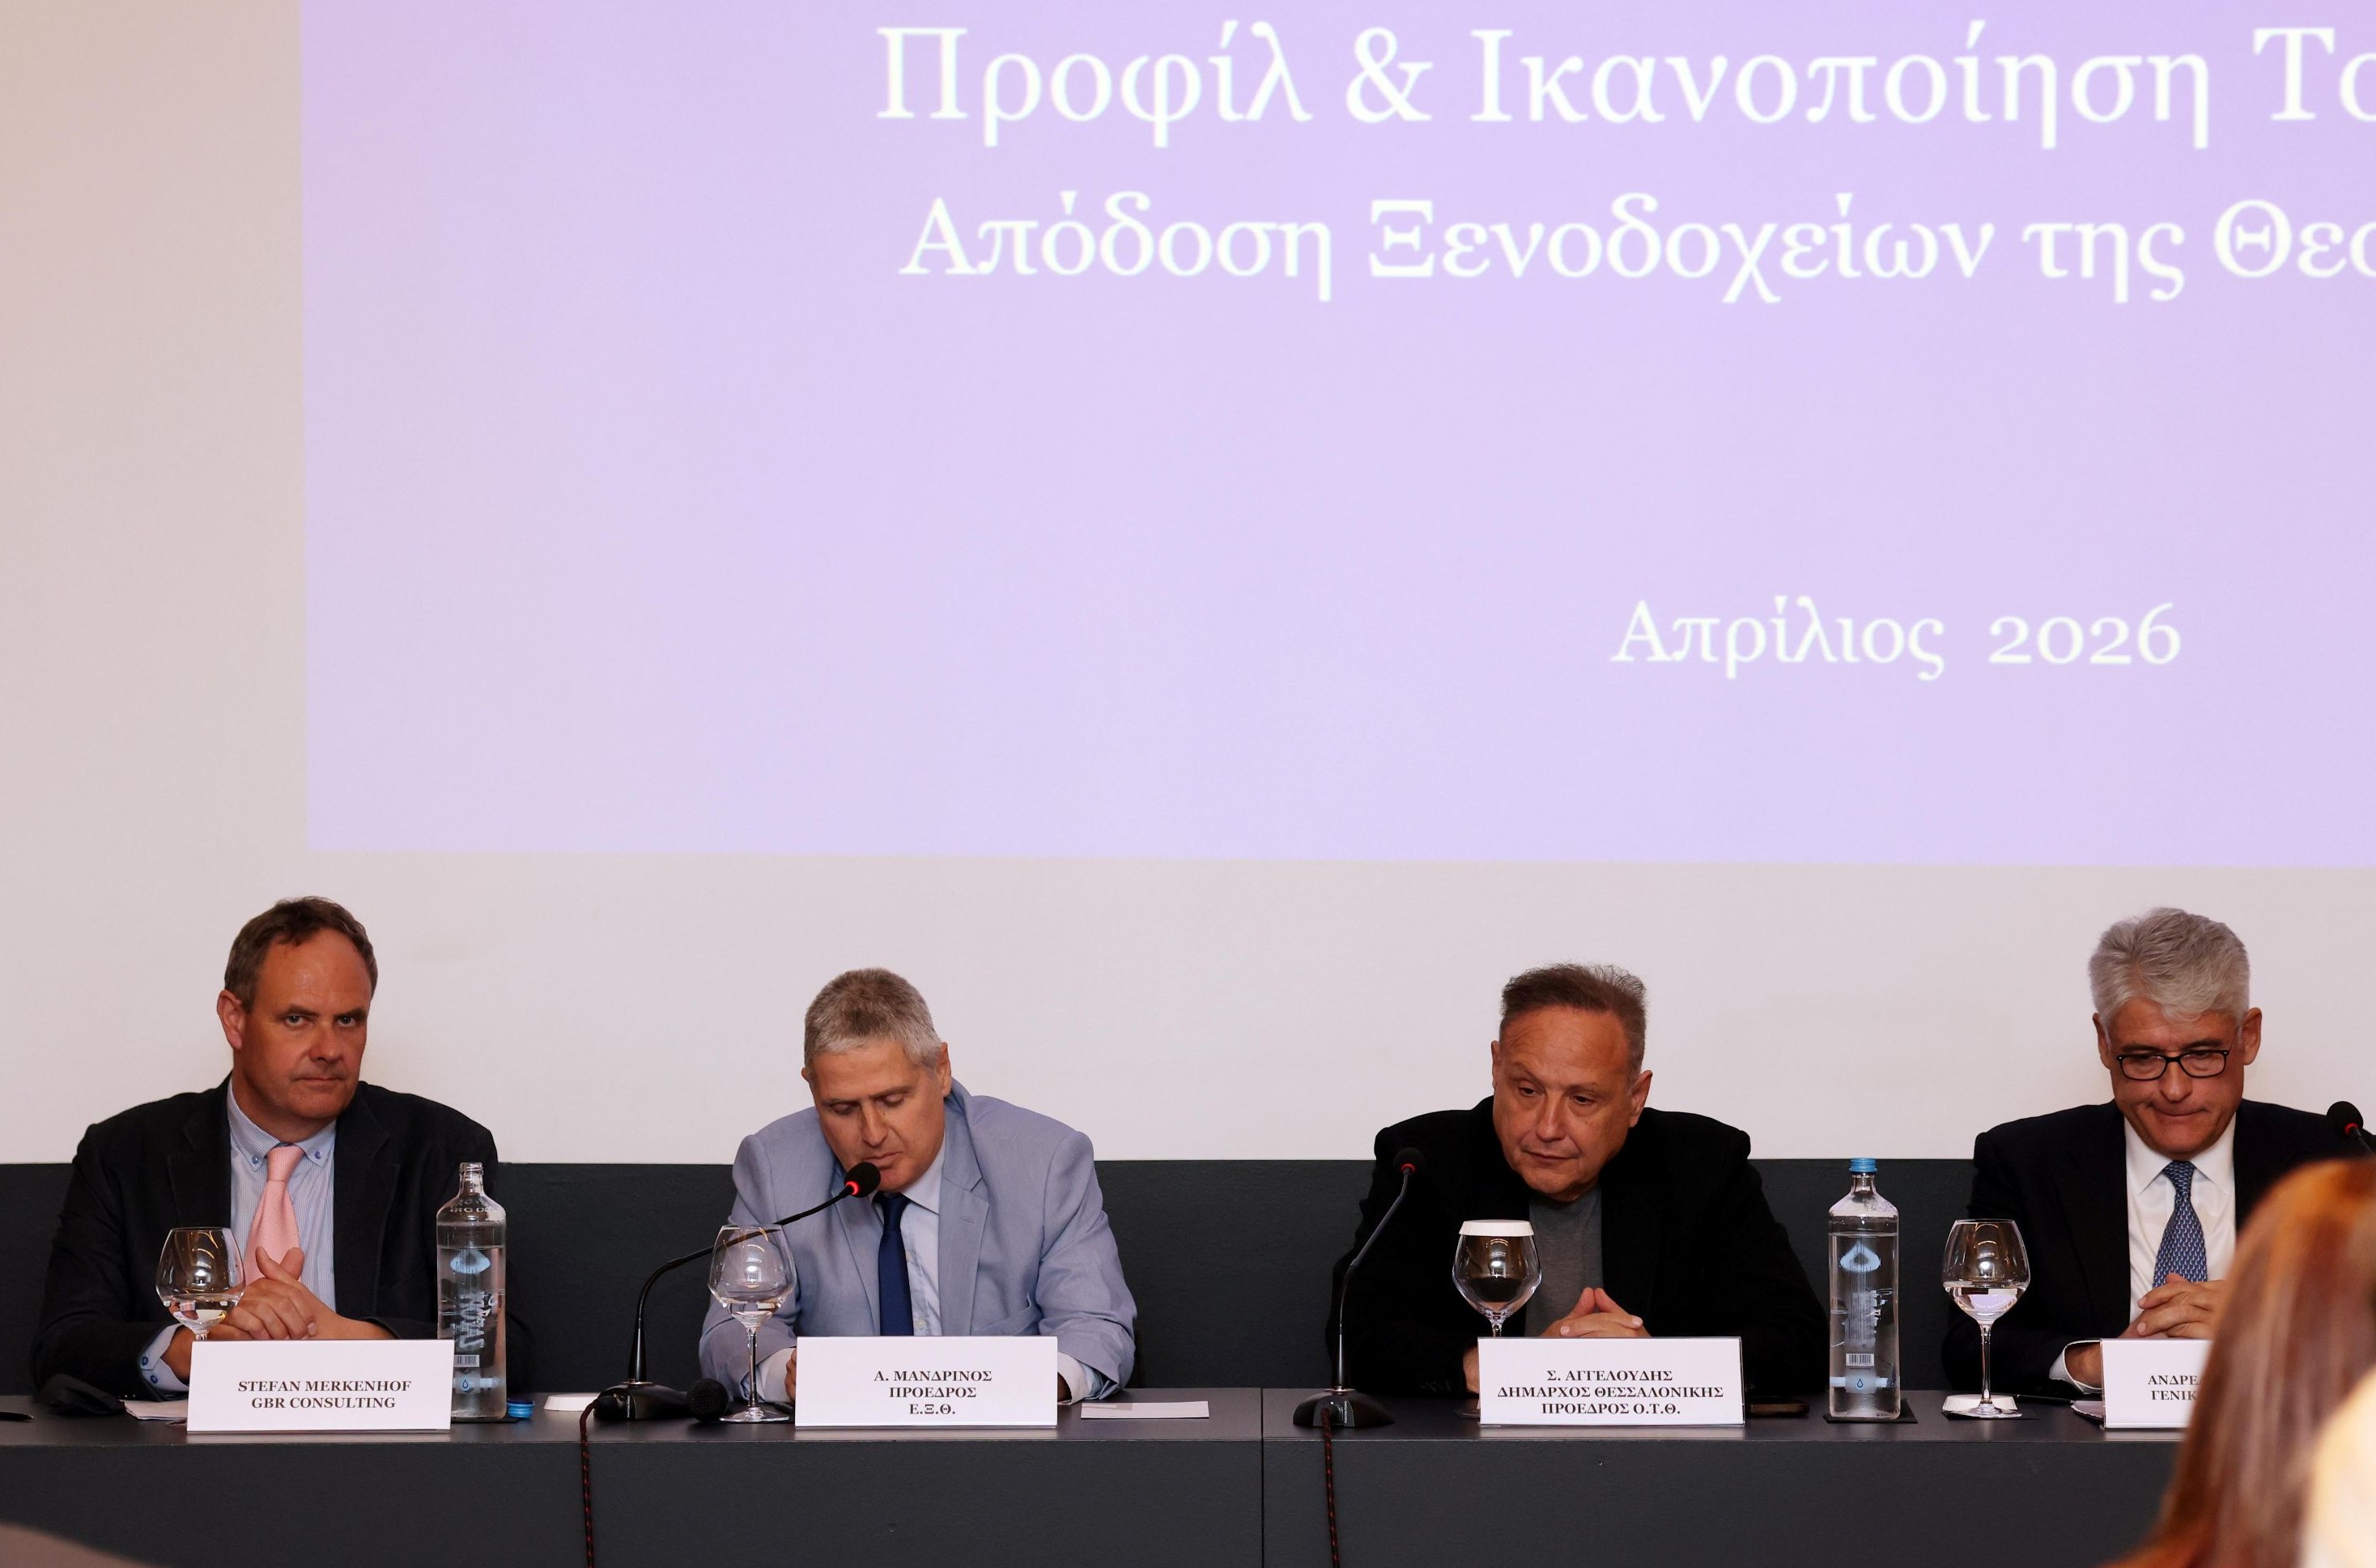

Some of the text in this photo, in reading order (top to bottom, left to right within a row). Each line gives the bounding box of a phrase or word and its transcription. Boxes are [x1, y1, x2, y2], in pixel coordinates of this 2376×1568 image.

[876, 19, 1314, 148] Προφίλ
[1345, 28, 1434, 124] &
[1470, 20, 2209, 149] Ικανοποίηση
[899, 190, 1332, 302] Απόδοση
[1369, 193, 1996, 304] Ξενοδοχείων
[2022, 222, 2186, 304] της
[1610, 595, 2181, 681] Απρίλιος 2026
[873, 1370, 992, 1382] Α. ΜΑΝΔΡΙΝΟΣ
[1546, 1370, 1673, 1382] Σ. ΑΓΓΕΛΟΥΔΗΣ
[2148, 1375, 2202, 1386] ΑΝΔΡΕ
[238, 1380, 412, 1392] STEFAN MERKENHOF
[889, 1387, 977, 1398] ΠΡΟΕΔΡΟΣ
[1497, 1387, 1724, 1398] ΔΗΜΑΡΧΟΣ ΘΕΣΣΑΛΟΝΙΚΗΣ
[251, 1397, 396, 1409] GBR CONSULTING
[1541, 1403, 1681, 1414] ΠΡΟΕΔΡΟΣ Ο.Τ.Θ.
[909, 1404, 956, 1415] Ε.Ξ.Θ.
